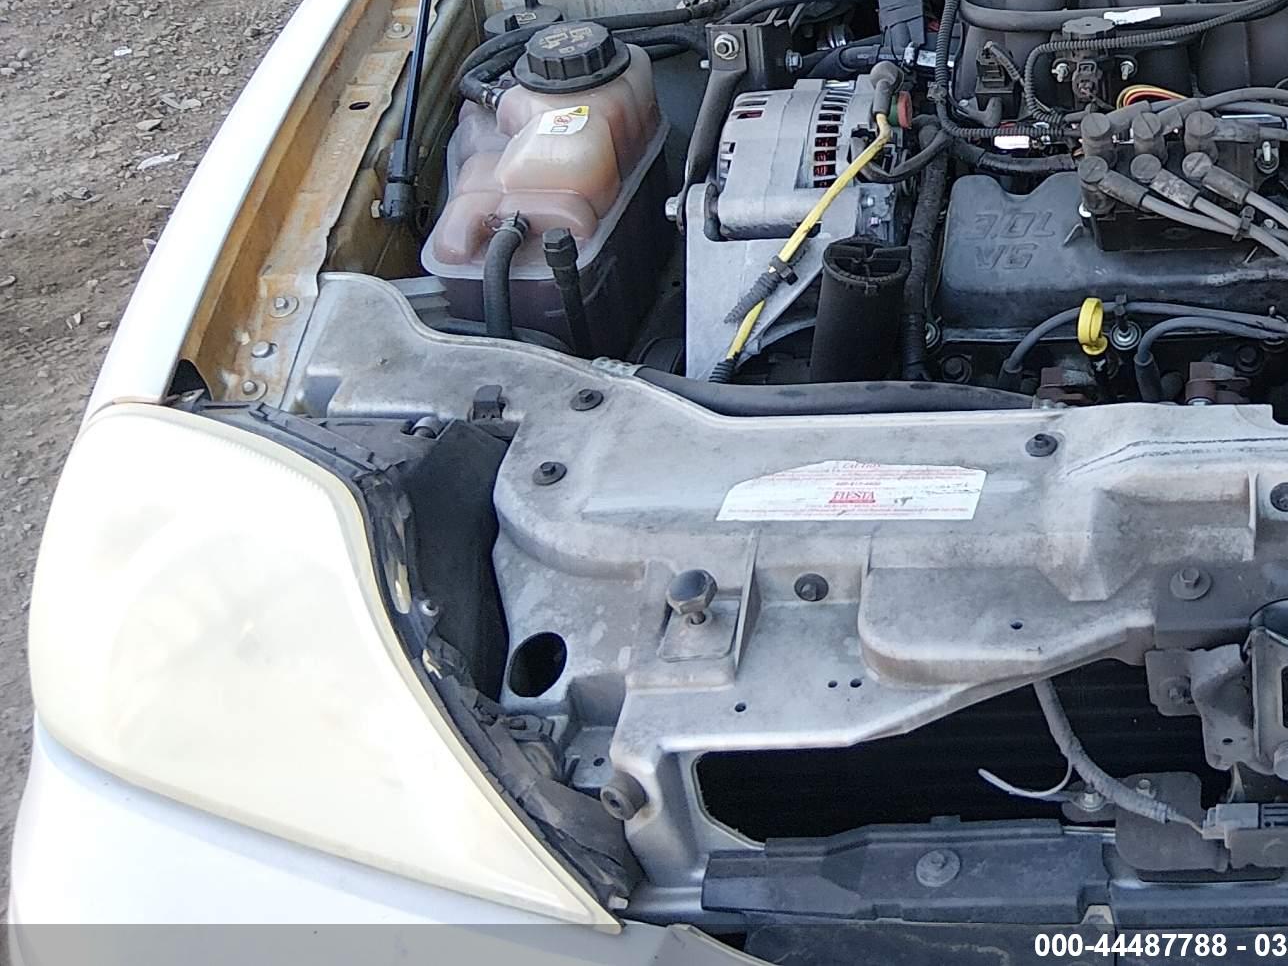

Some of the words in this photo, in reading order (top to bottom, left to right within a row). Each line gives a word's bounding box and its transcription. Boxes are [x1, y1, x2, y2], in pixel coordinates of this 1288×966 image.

[966, 211, 1056, 241] 3.0L
[974, 242, 1040, 270] V6
[833, 490, 876, 500] FIESTA
